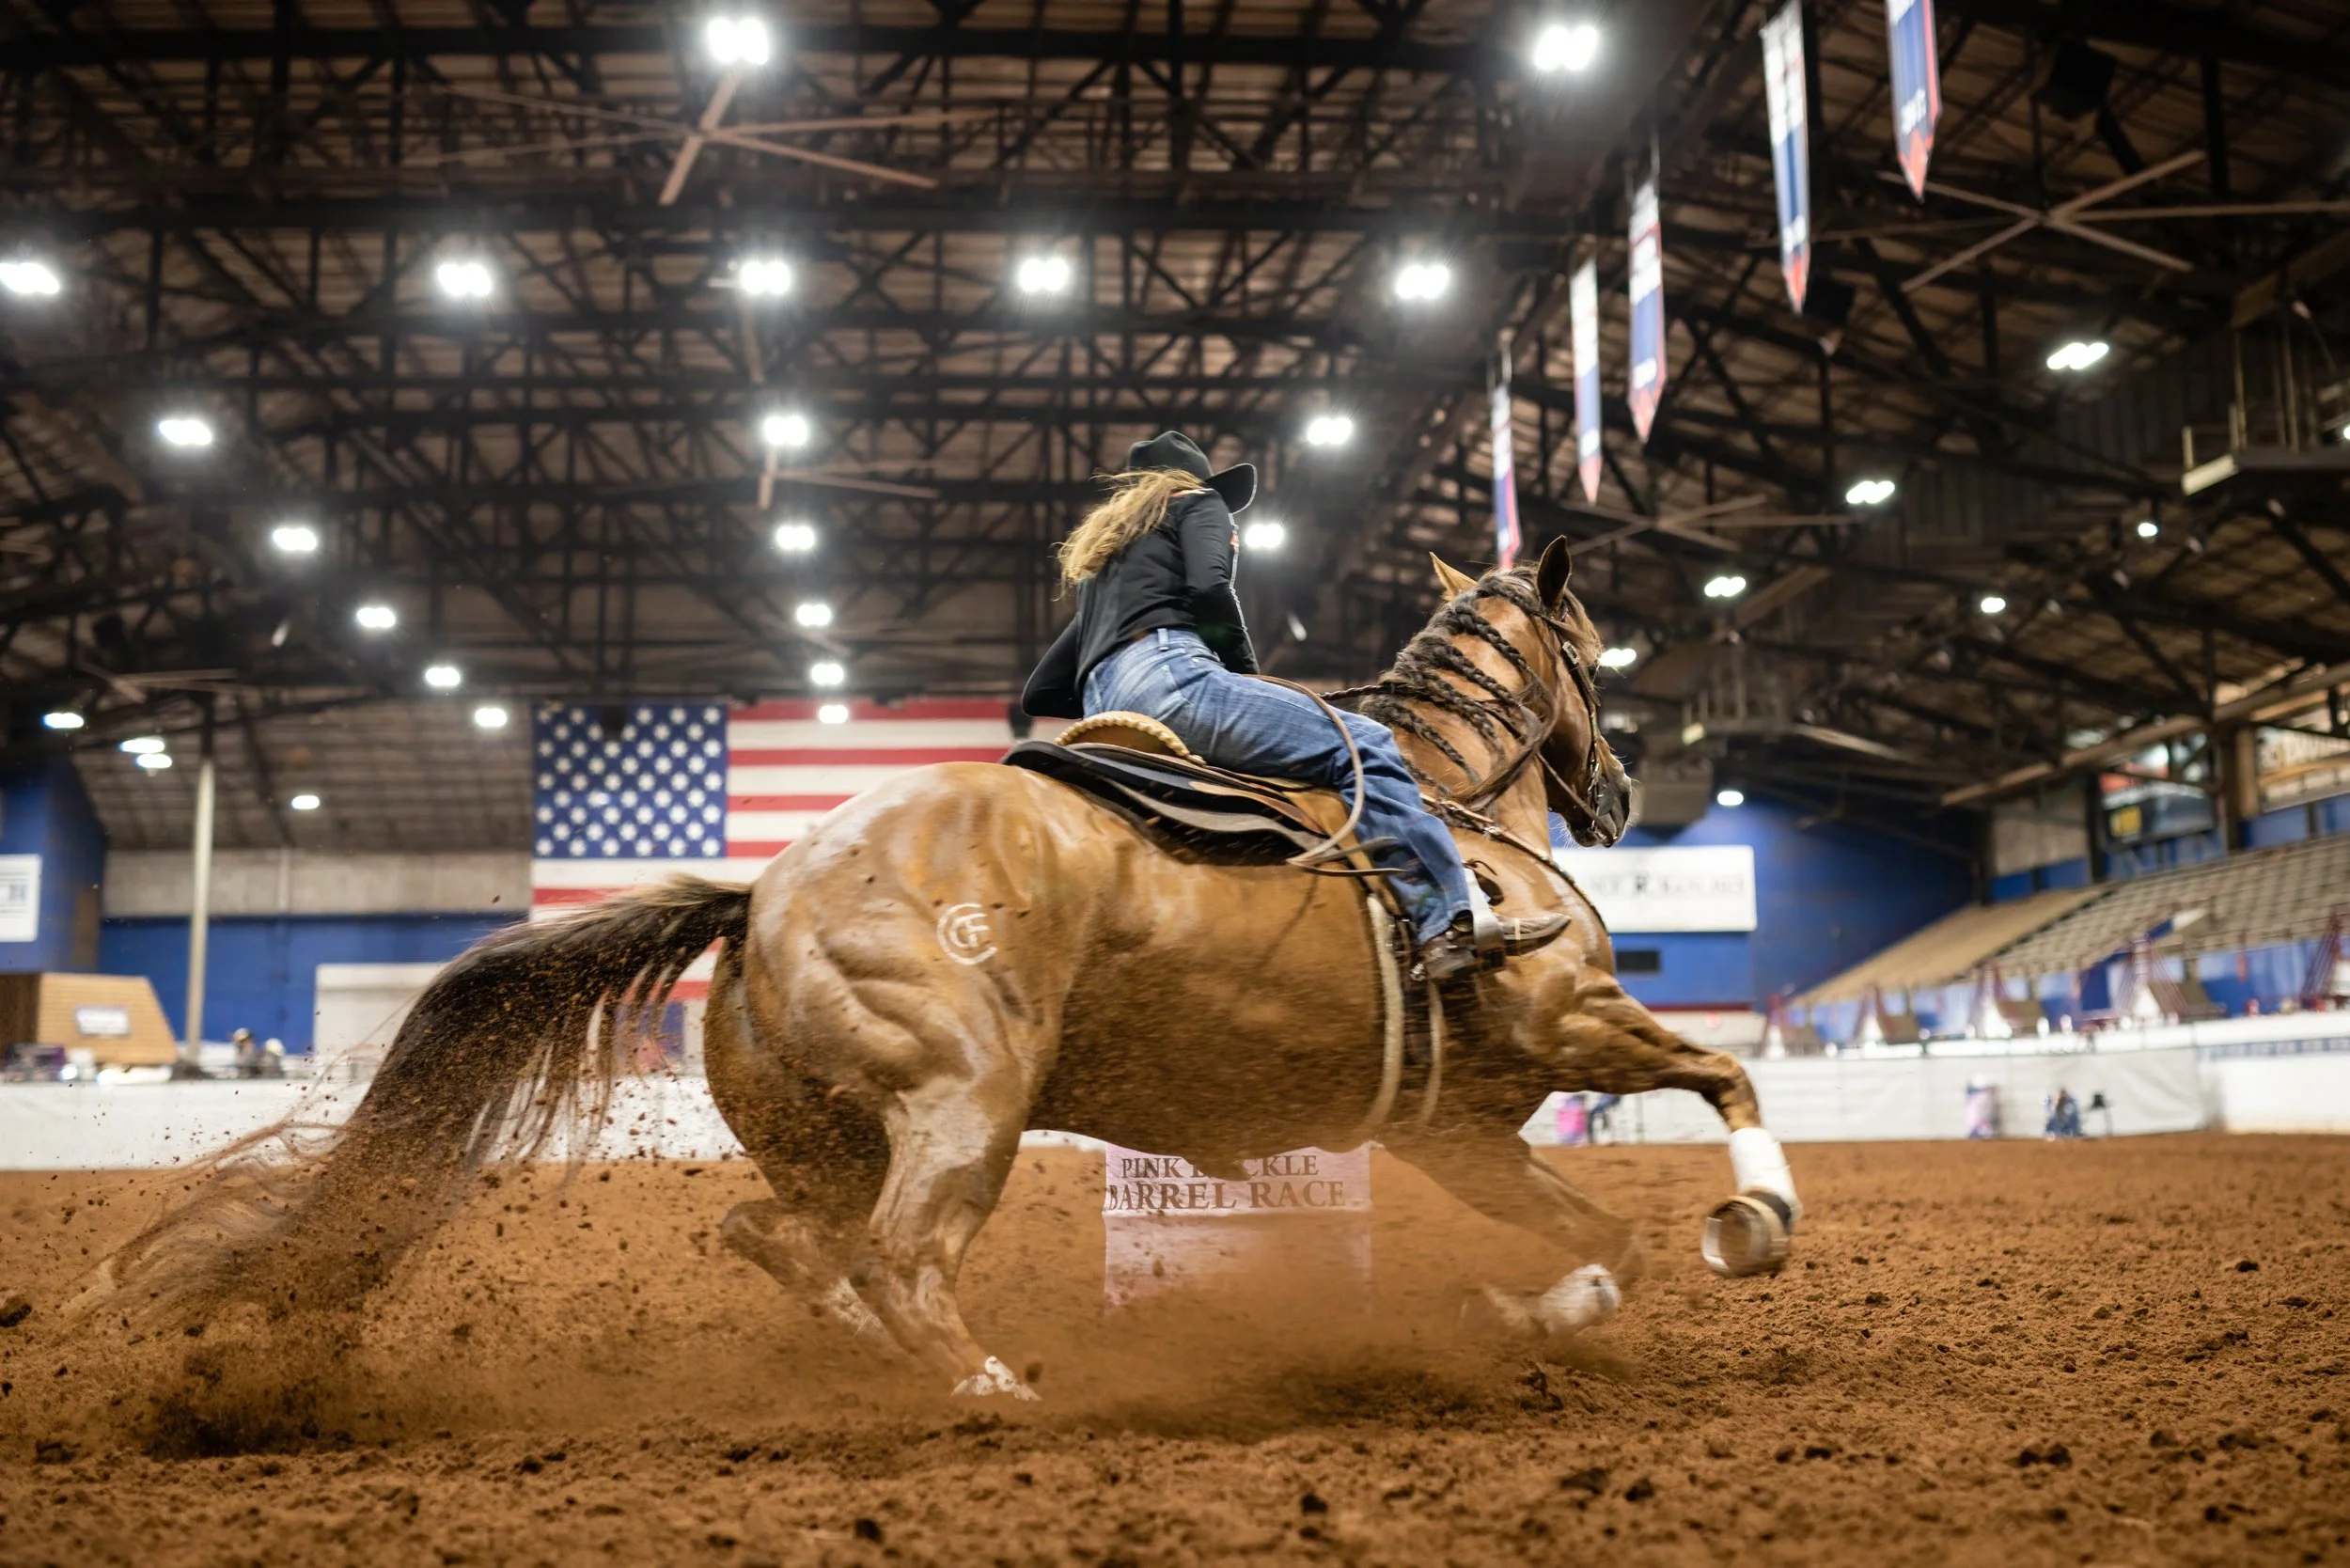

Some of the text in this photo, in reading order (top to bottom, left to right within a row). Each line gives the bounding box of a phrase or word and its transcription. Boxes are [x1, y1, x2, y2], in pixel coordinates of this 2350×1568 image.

[1121, 1155, 1319, 1178] PINK CKLE
[1108, 1181, 1345, 1210] BARREL RACE
